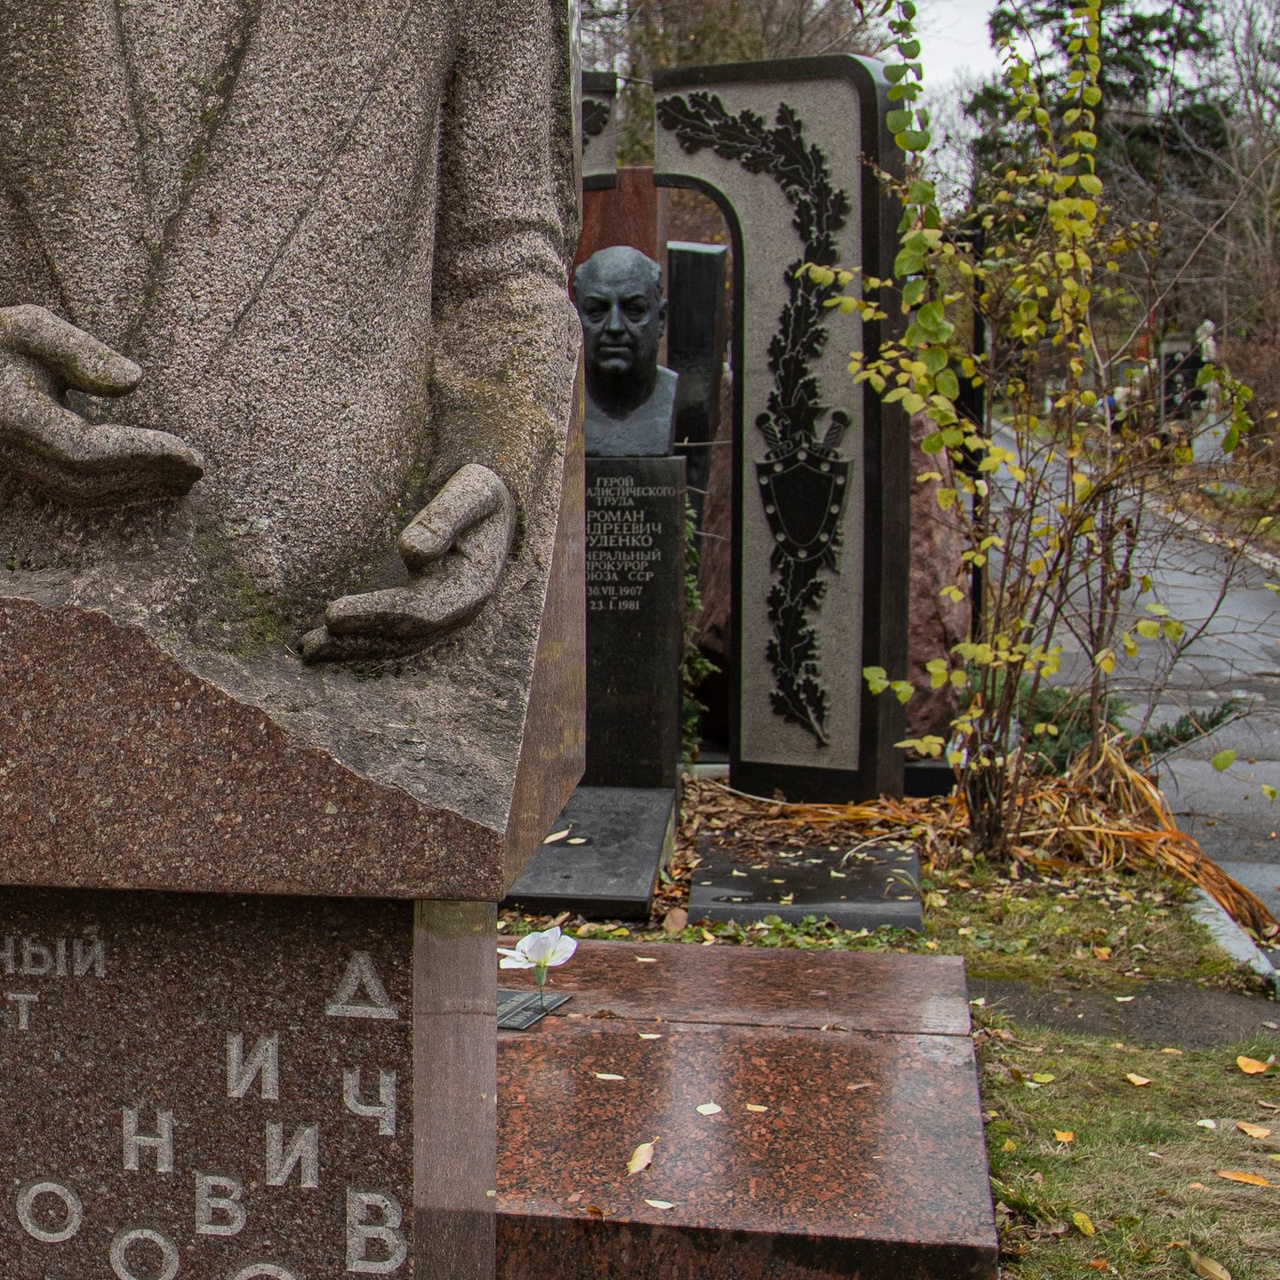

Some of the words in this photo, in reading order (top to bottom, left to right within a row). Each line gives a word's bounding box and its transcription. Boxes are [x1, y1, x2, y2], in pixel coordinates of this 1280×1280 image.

[596, 475, 634, 487] ГЕРОЙ
[586, 486, 676, 497] АЛИСТИЧЕСКОГО
[596, 496, 635, 507] ТРУДА
[587, 510, 645, 522] РОМАН
[586, 522, 662, 534] ДРЕЕВИЧ
[585, 548, 661, 560] НЕРАЛЬНЫЙ
[585, 571, 619, 581] ОЮЗА
[627, 571, 654, 581] ССР
